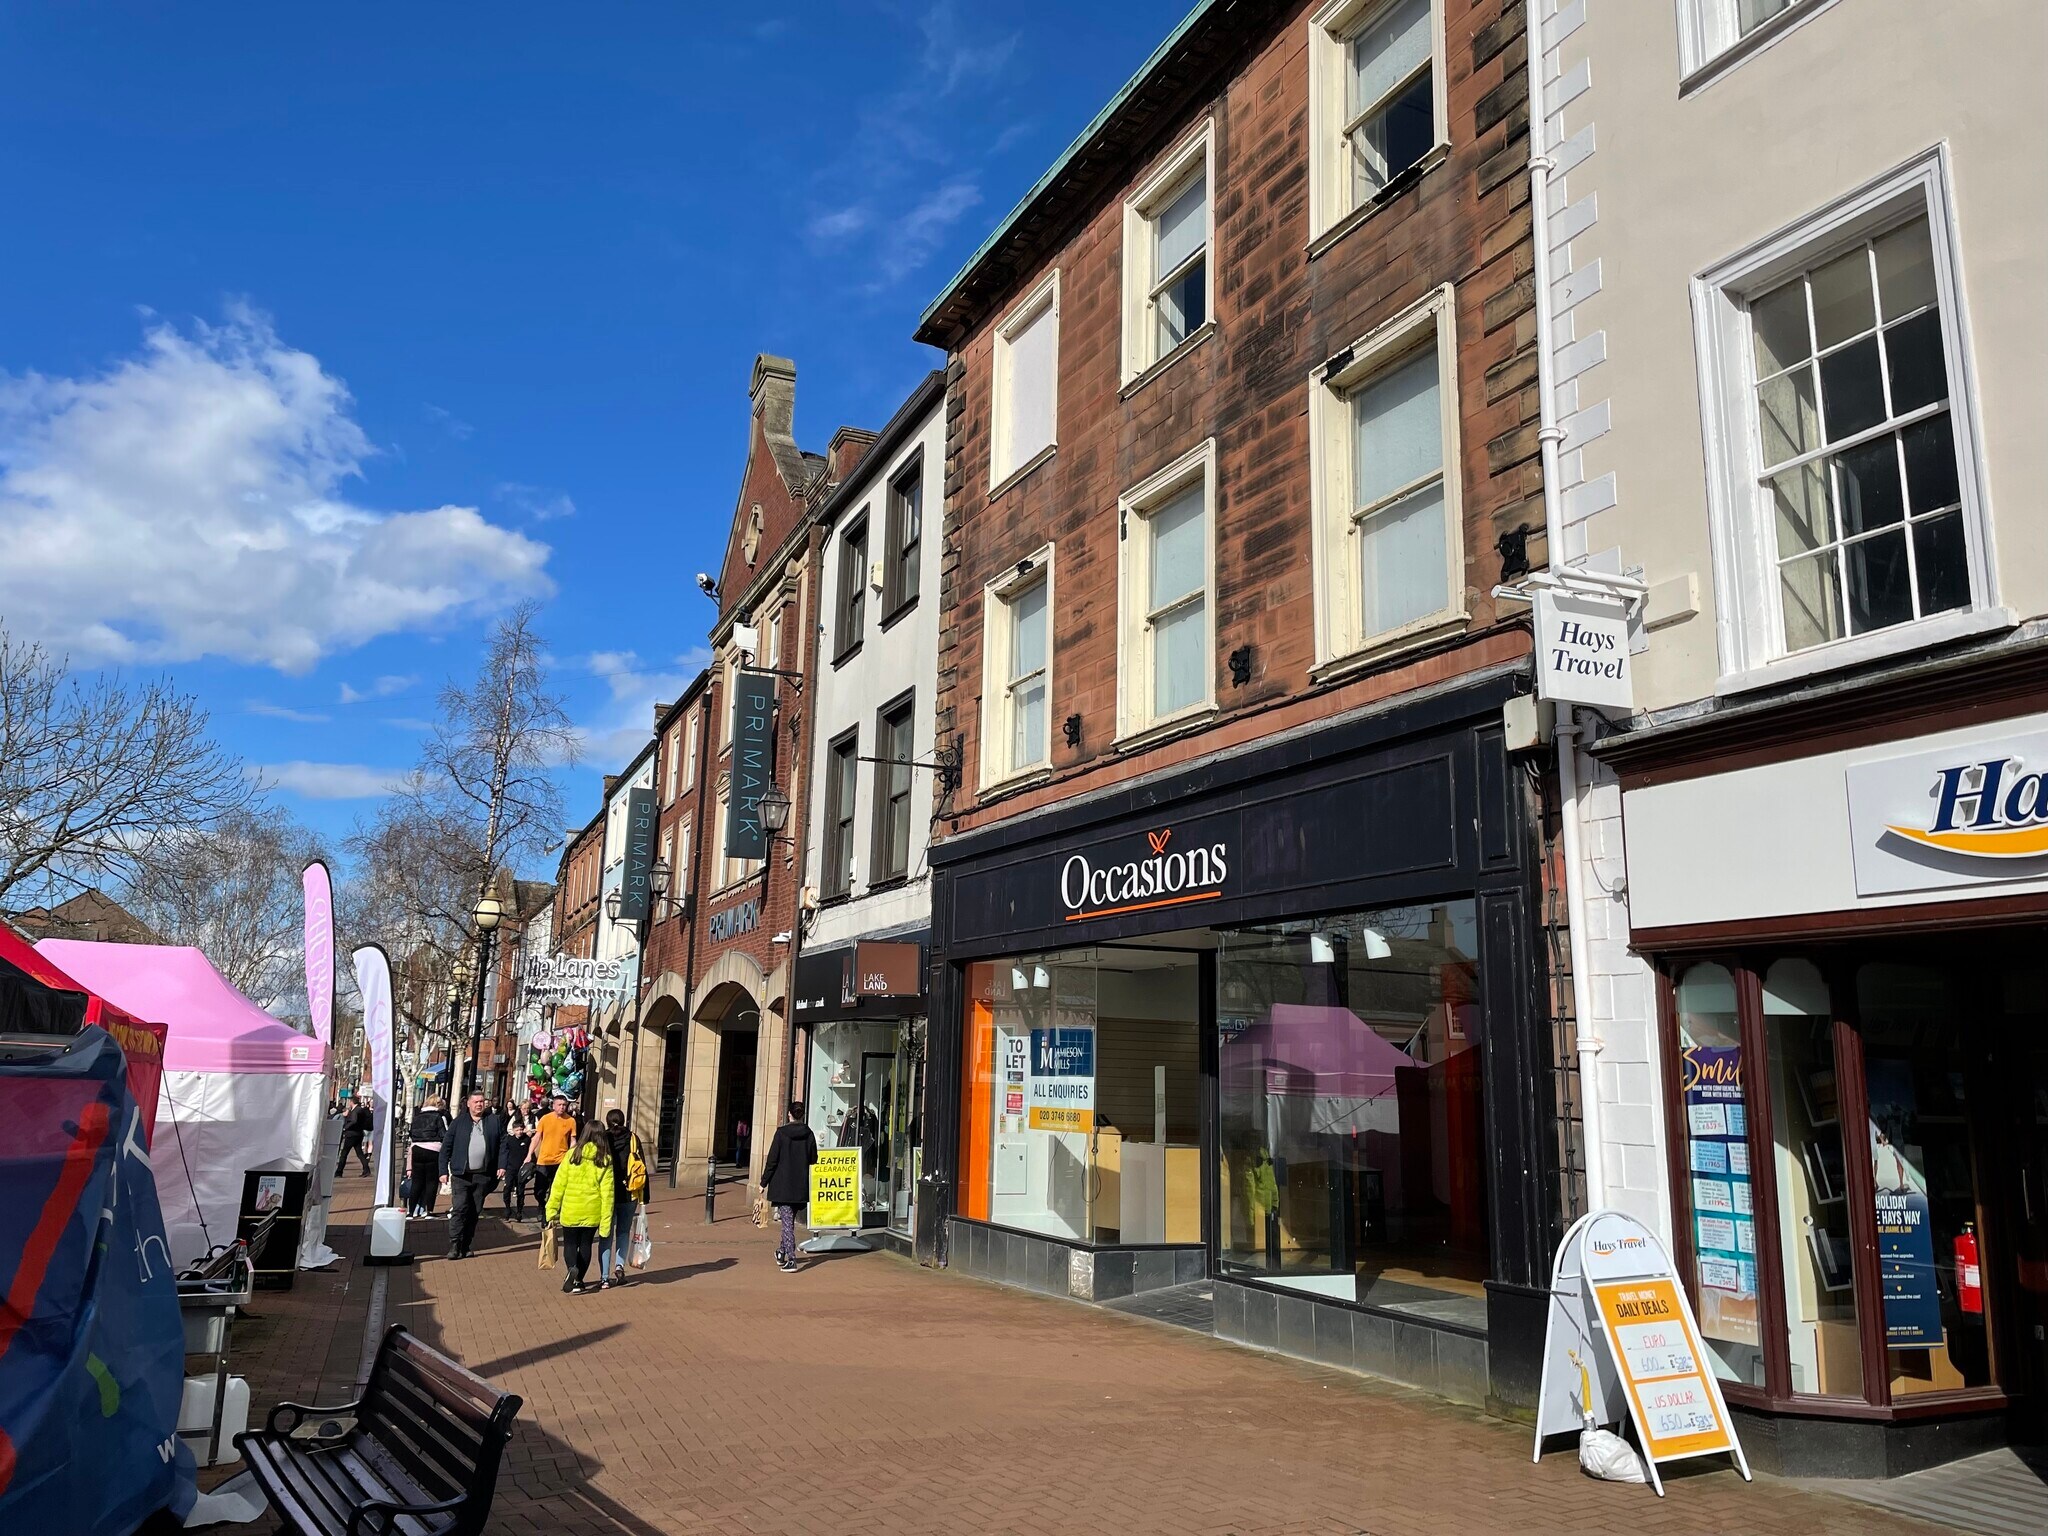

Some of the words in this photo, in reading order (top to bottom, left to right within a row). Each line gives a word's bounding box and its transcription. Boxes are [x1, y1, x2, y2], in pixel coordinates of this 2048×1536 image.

[1558, 620, 1615, 653] Hays
[1551, 649, 1624, 681] Travel
[738, 694, 766, 835] PRIMARK
[629, 802, 650, 904] PRIMARK
[1061, 842, 1227, 909] Occasions
[708, 901, 759, 943] PRIMARK
[554, 953, 620, 980] Lanes
[863, 973, 884, 982] LAKE
[524, 985, 568, 999] Spping
[571, 985, 617, 999] Centre
[863, 981, 888, 991] LAND
[1008, 1039, 1023, 1053] TO
[1054, 1047, 1083, 1058] JAMIESON
[1006, 1055, 1026, 1069] LET
[1053, 1059, 1070, 1070] MILLS
[1682, 1046, 1743, 1092] Smil
[1033, 1084, 1047, 1098] ALL
[1048, 1084, 1088, 1099] ENQUIRIES
[1039, 1110, 1049, 1120] 020
[1051, 1111, 1065, 1121] 3746
[815, 1157, 857, 1165] LEATHER
[814, 1165, 857, 1173] CLEARANCE
[819, 1177, 852, 1188] HALF
[817, 1190, 853, 1202] PRICE
[1875, 1195, 1907, 1210] HOLIDAY
[1881, 1210, 1902, 1225] HAYS
[1903, 1210, 1921, 1225] WAY
[1594, 1240, 1617, 1251] Hays
[1617, 1238, 1647, 1250] Travel
[1618, 1291, 1639, 1302] TRAVEL
[1637, 1289, 1656, 1300] MONEY
[1616, 1301, 1641, 1318] DAILY
[1641, 1299, 1669, 1316] DEALS
[1642, 1334, 1666, 1349] EURO
[1654, 1395, 1667, 1409] US
[1667, 1390, 1694, 1407] DOLLAR
[1661, 1413, 1683, 1432] 650
